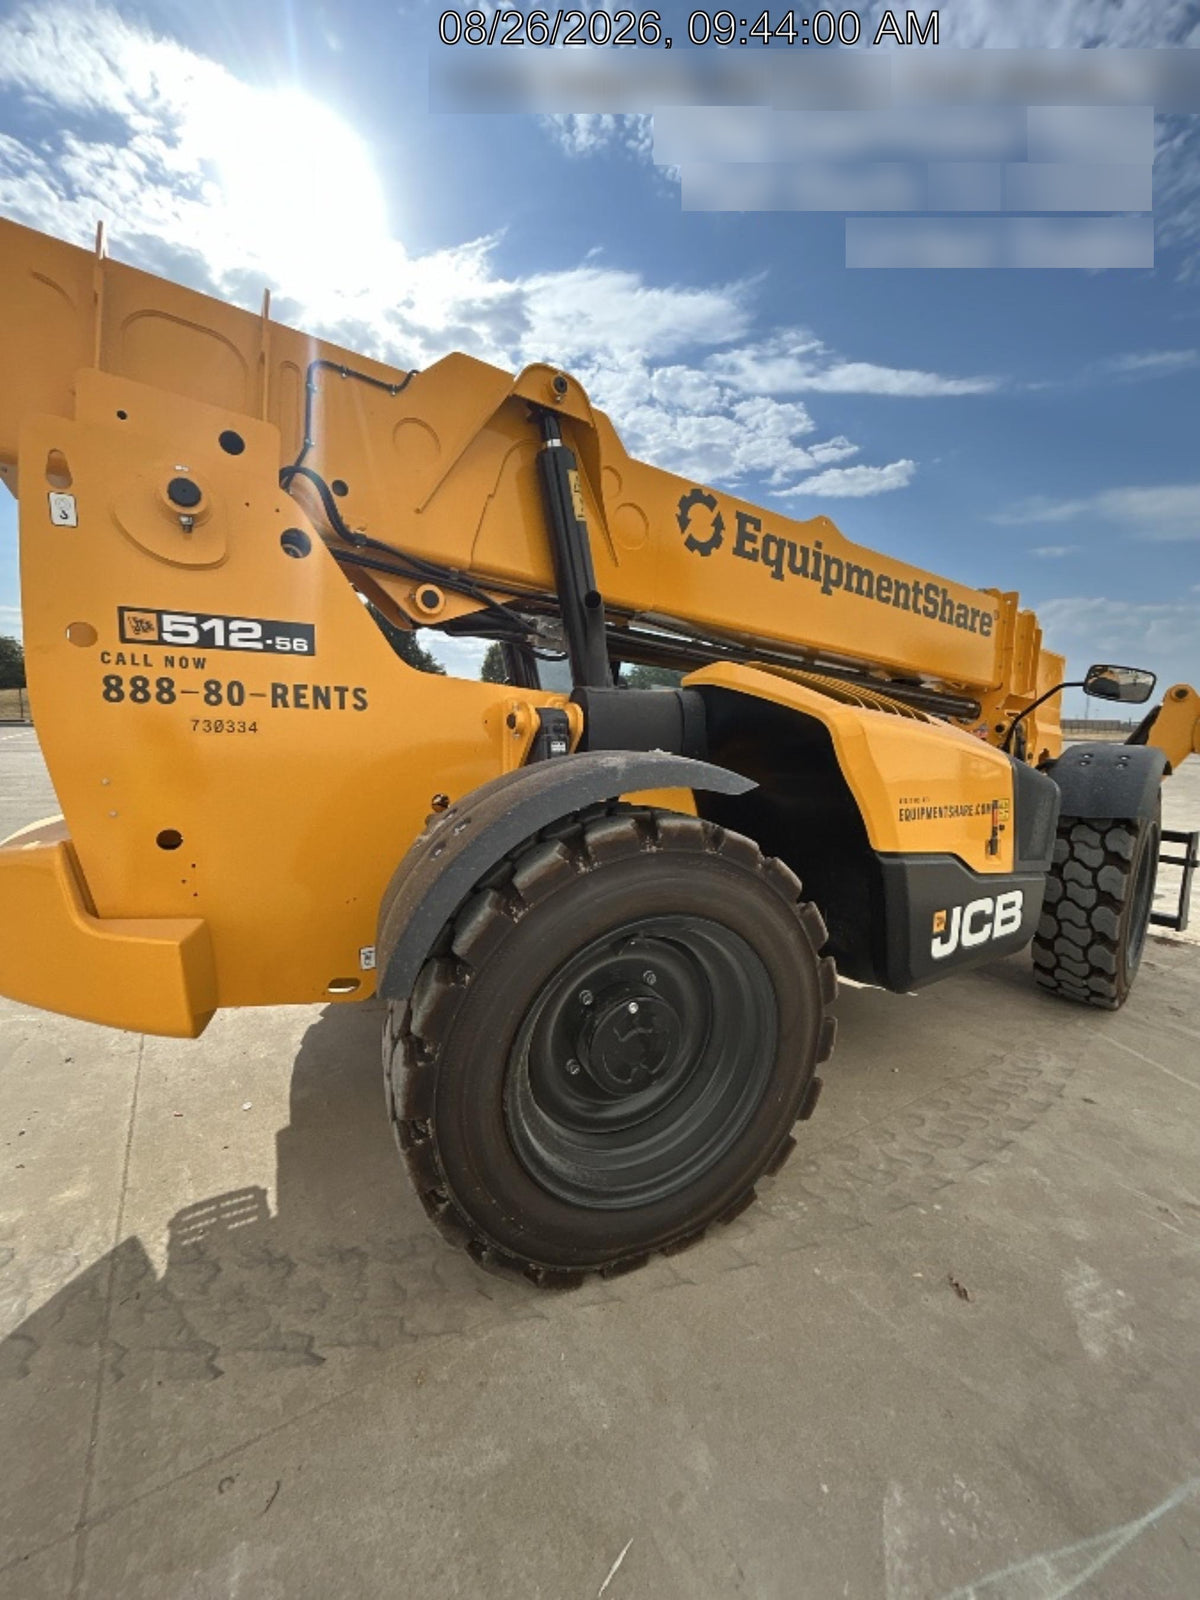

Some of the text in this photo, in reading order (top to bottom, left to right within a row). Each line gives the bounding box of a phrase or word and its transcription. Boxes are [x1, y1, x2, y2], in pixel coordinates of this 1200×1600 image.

[732, 510, 993, 637] EquipmentShare
[100, 651, 207, 670] CALL NOW
[191, 719, 259, 734] 730334
[931, 890, 1024, 960] JCB
